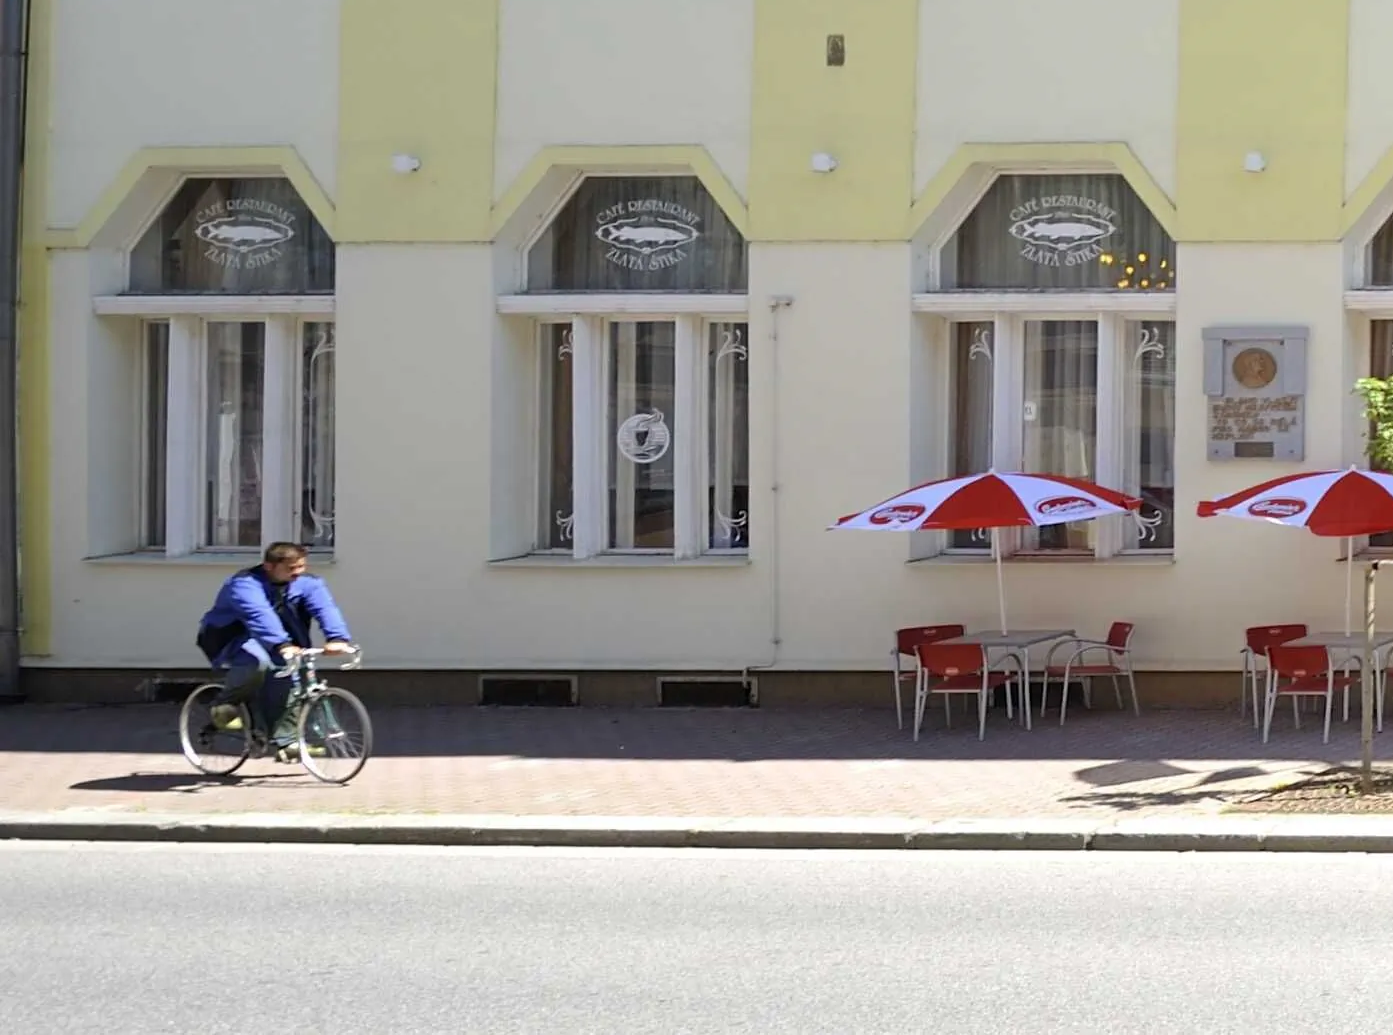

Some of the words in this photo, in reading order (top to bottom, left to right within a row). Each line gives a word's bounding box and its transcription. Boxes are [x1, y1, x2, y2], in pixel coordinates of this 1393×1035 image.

[627, 200, 700, 226] RESTAURANT
[1041, 195, 1117, 220] RESTAURANT
[605, 246, 642, 271] ZLATÁ
[648, 248, 687, 271] ŠTIKA
[1021, 244, 1059, 267] ZLATÁ
[1065, 244, 1104, 267] ŠTIKA
